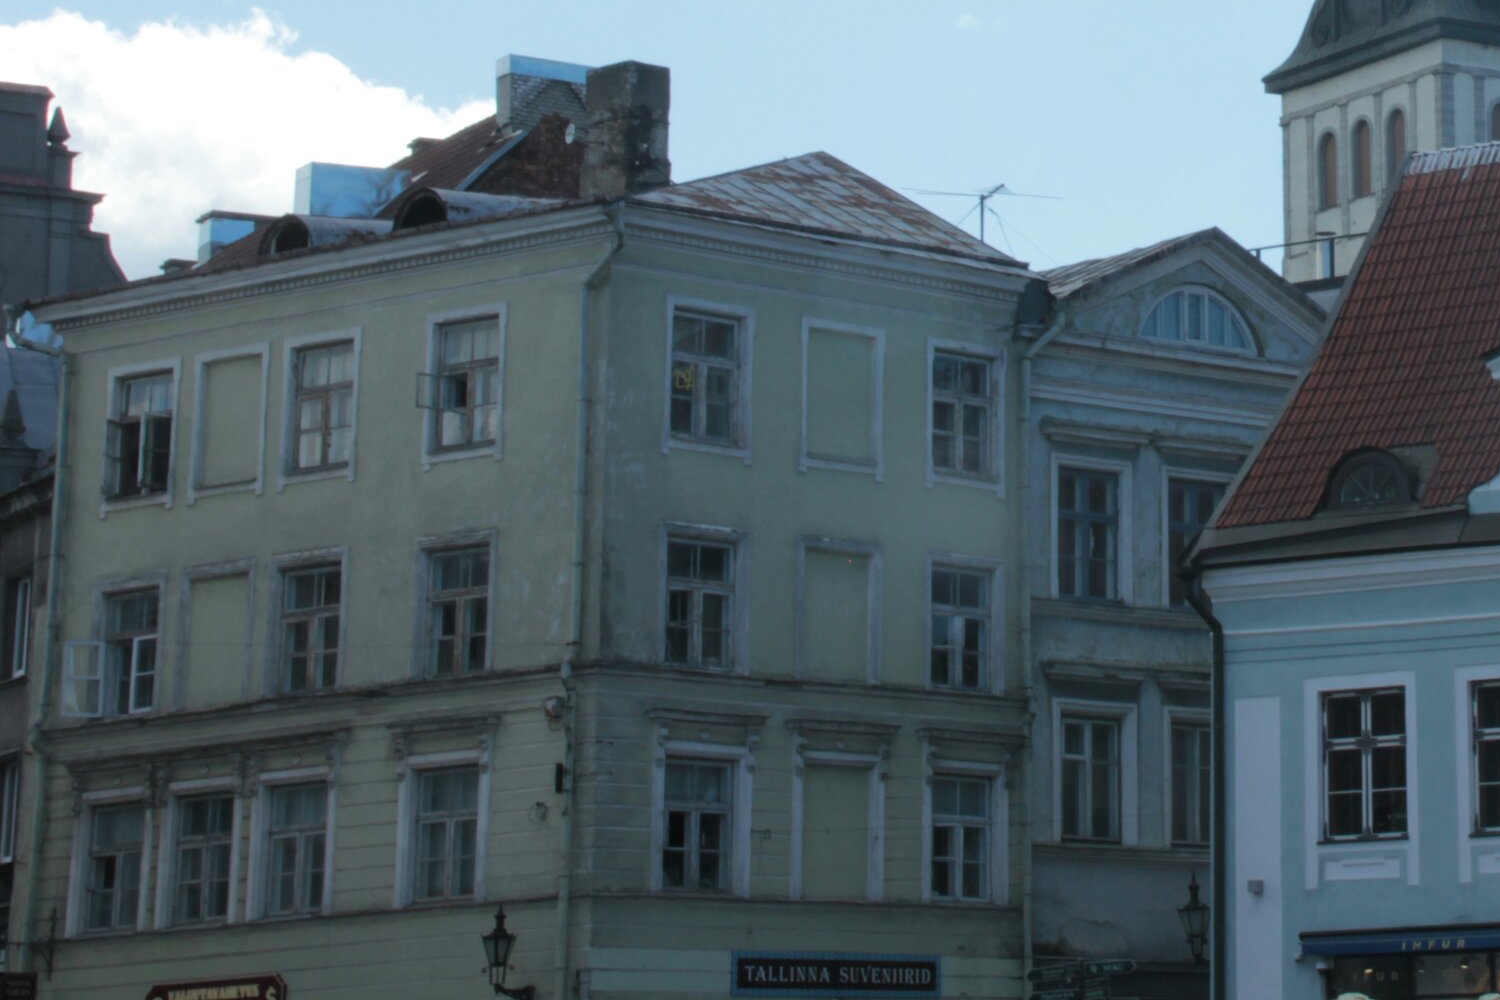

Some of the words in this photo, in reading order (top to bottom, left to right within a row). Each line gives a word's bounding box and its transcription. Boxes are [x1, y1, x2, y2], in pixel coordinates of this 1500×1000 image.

[1401, 938, 1466, 951] INFUR
[744, 964, 831, 983] TALLINNA
[839, 965, 932, 985] SUVENIIRID
